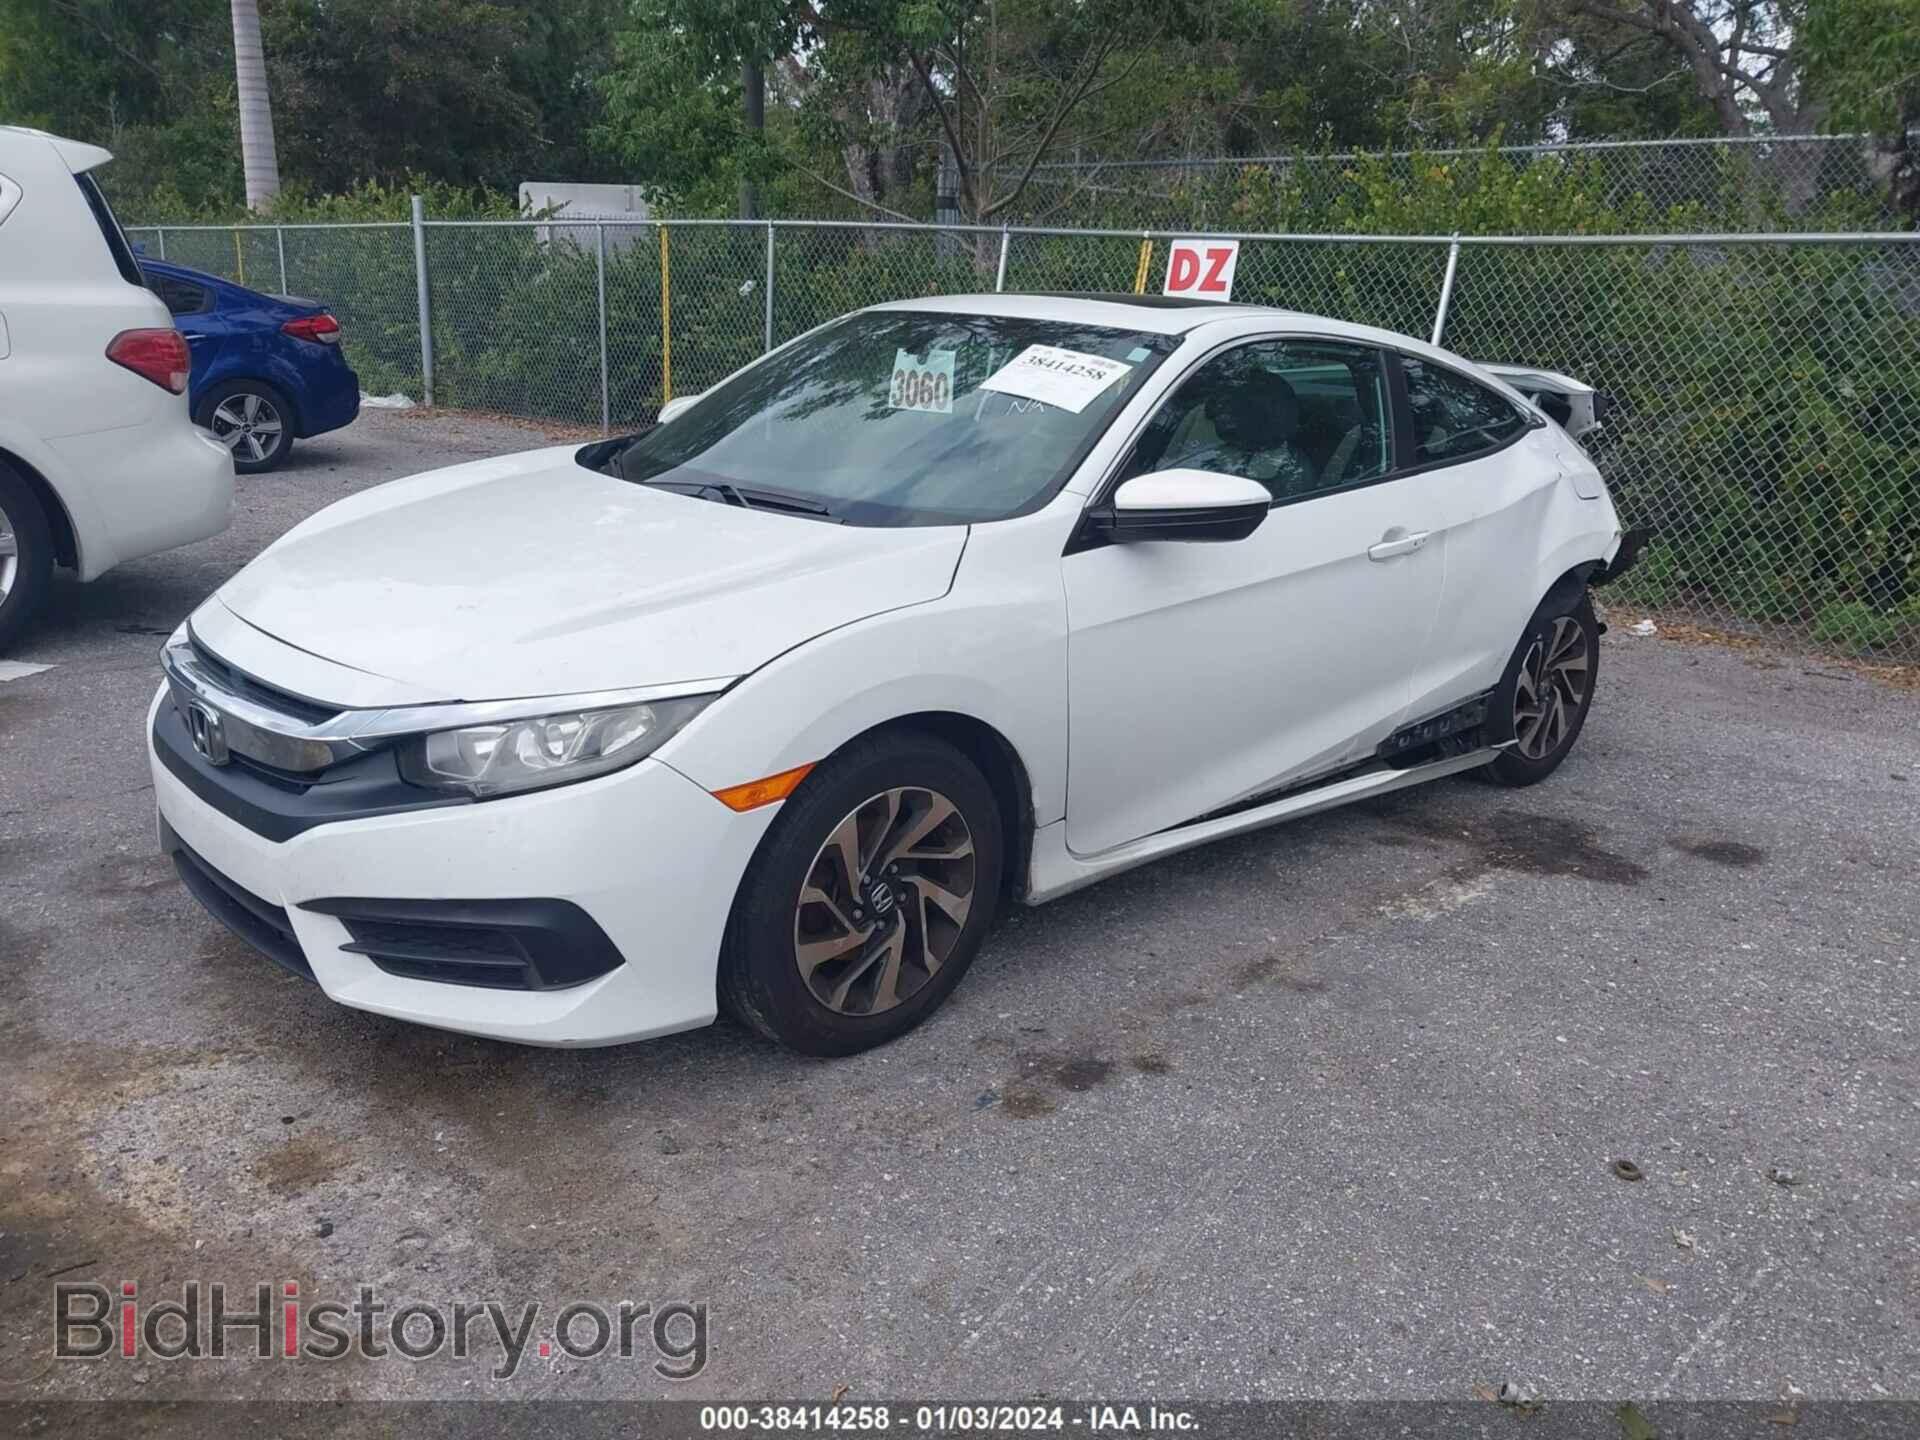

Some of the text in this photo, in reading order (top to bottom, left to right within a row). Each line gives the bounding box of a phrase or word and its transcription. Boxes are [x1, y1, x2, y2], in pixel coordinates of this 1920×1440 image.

[1167, 248, 1234, 292] DZ
[1022, 355, 1107, 381] 38414258
[893, 369, 949, 411] 3060
